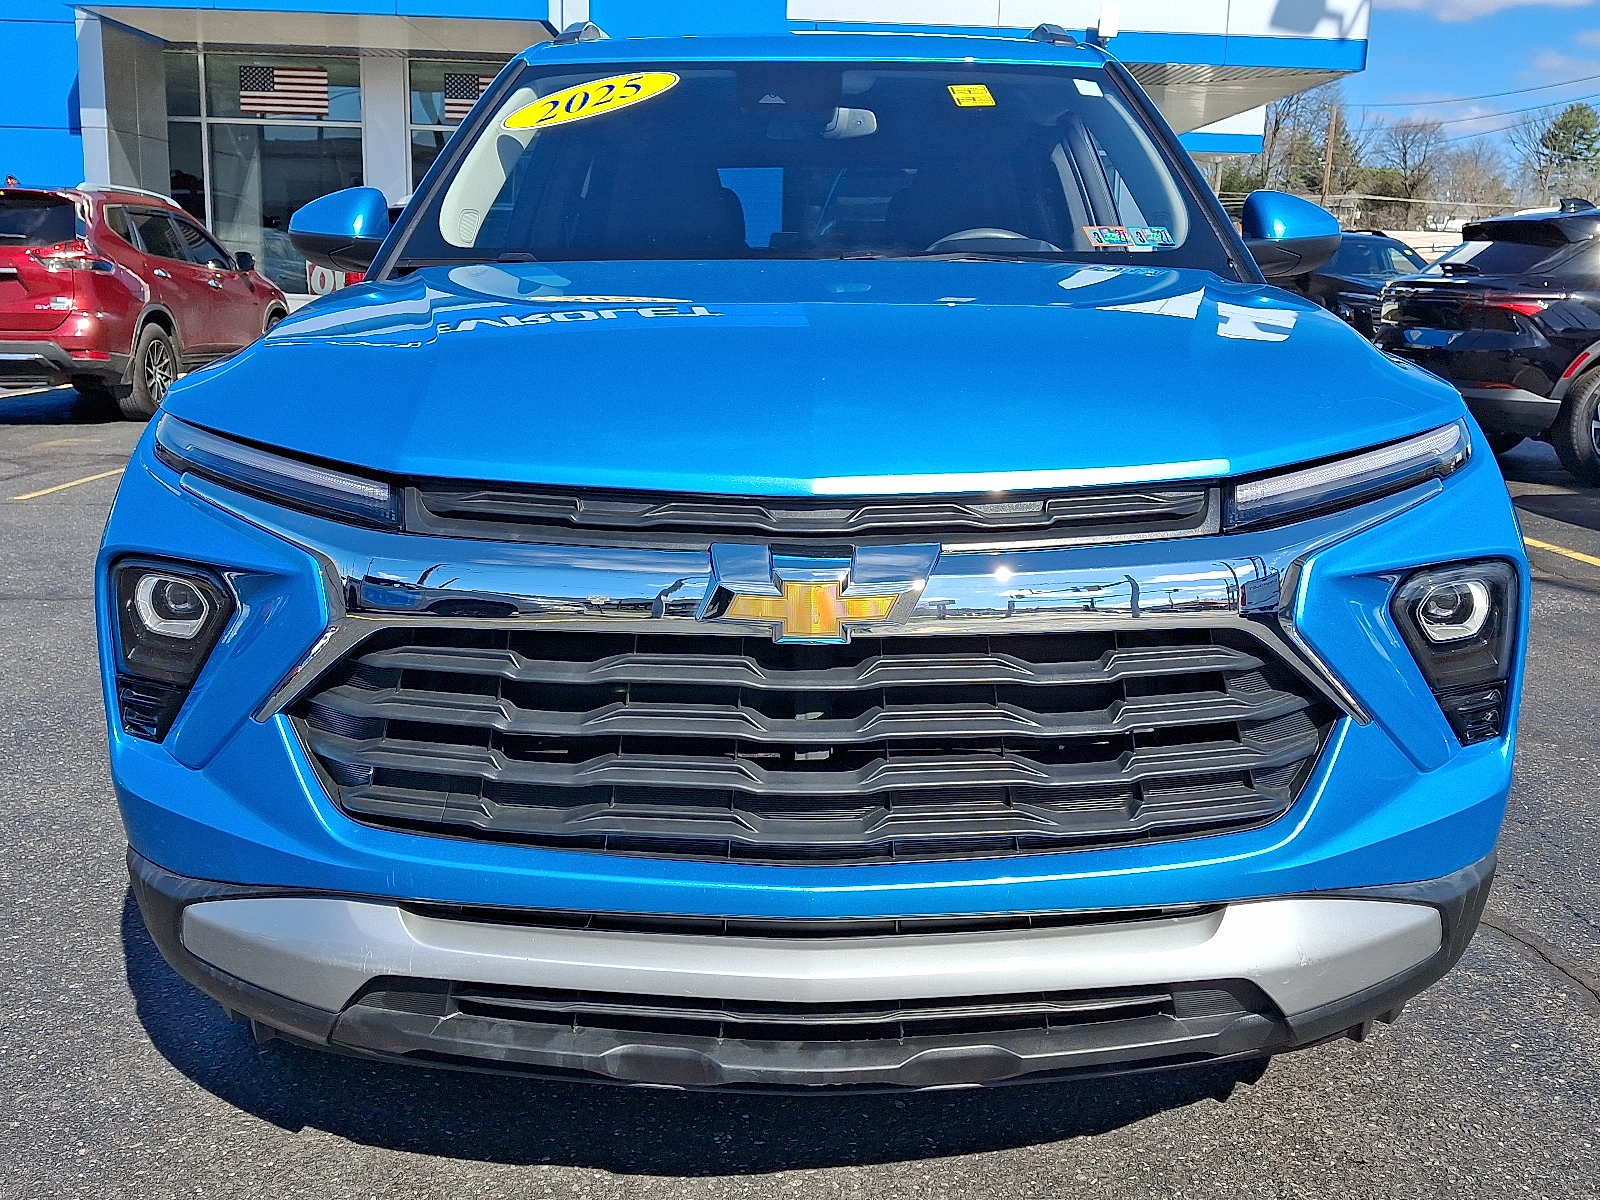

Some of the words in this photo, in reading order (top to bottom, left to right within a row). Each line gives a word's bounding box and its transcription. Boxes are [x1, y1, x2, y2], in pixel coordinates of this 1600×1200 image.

[535, 76, 644, 124] 2025
[1092, 231, 1103, 244] 3
[1135, 231, 1146, 243] 3
